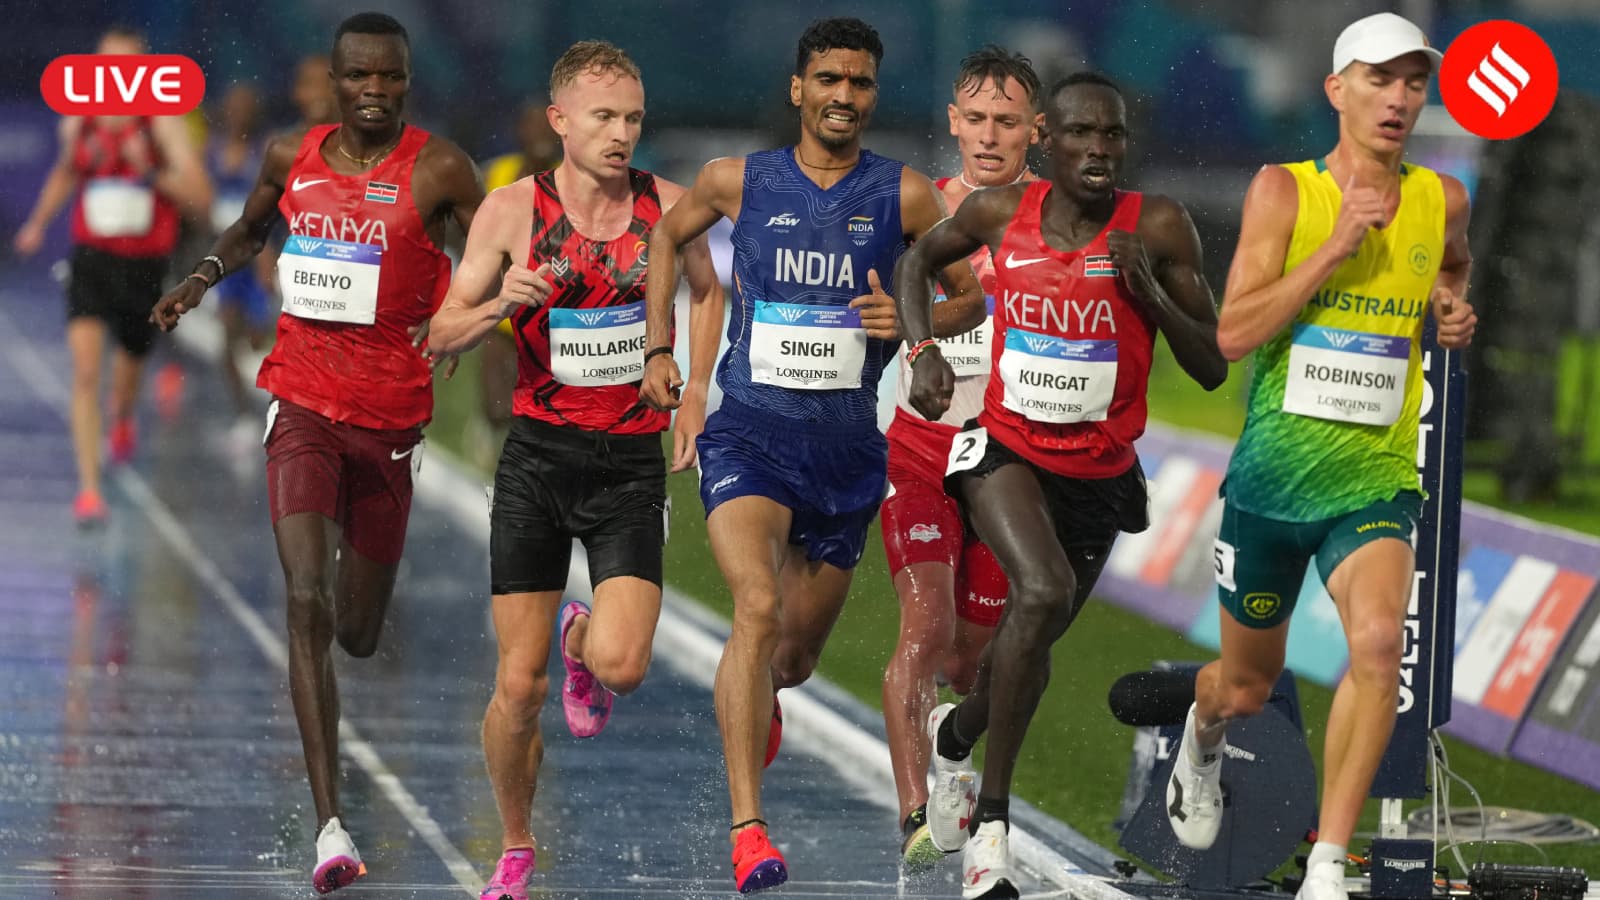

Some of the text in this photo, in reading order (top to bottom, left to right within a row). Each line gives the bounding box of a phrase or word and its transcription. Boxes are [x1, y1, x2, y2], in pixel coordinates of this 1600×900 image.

[764, 216, 800, 227] JSW
[848, 222, 874, 232] INDIA
[775, 248, 854, 289] INDIA
[293, 270, 351, 289] EBENYO
[293, 296, 346, 310] LONGINES
[1004, 289, 1117, 334] KENYA
[780, 340, 835, 357] SINGH
[582, 363, 642, 377] LONGINES
[776, 367, 838, 379] LONGINES
[1305, 363, 1396, 390] ROBINSON
[1019, 369, 1089, 391] KURGAT
[1020, 397, 1082, 413] LONGINES
[1317, 394, 1381, 412] LONGINES
[956, 437, 976, 462] 2
